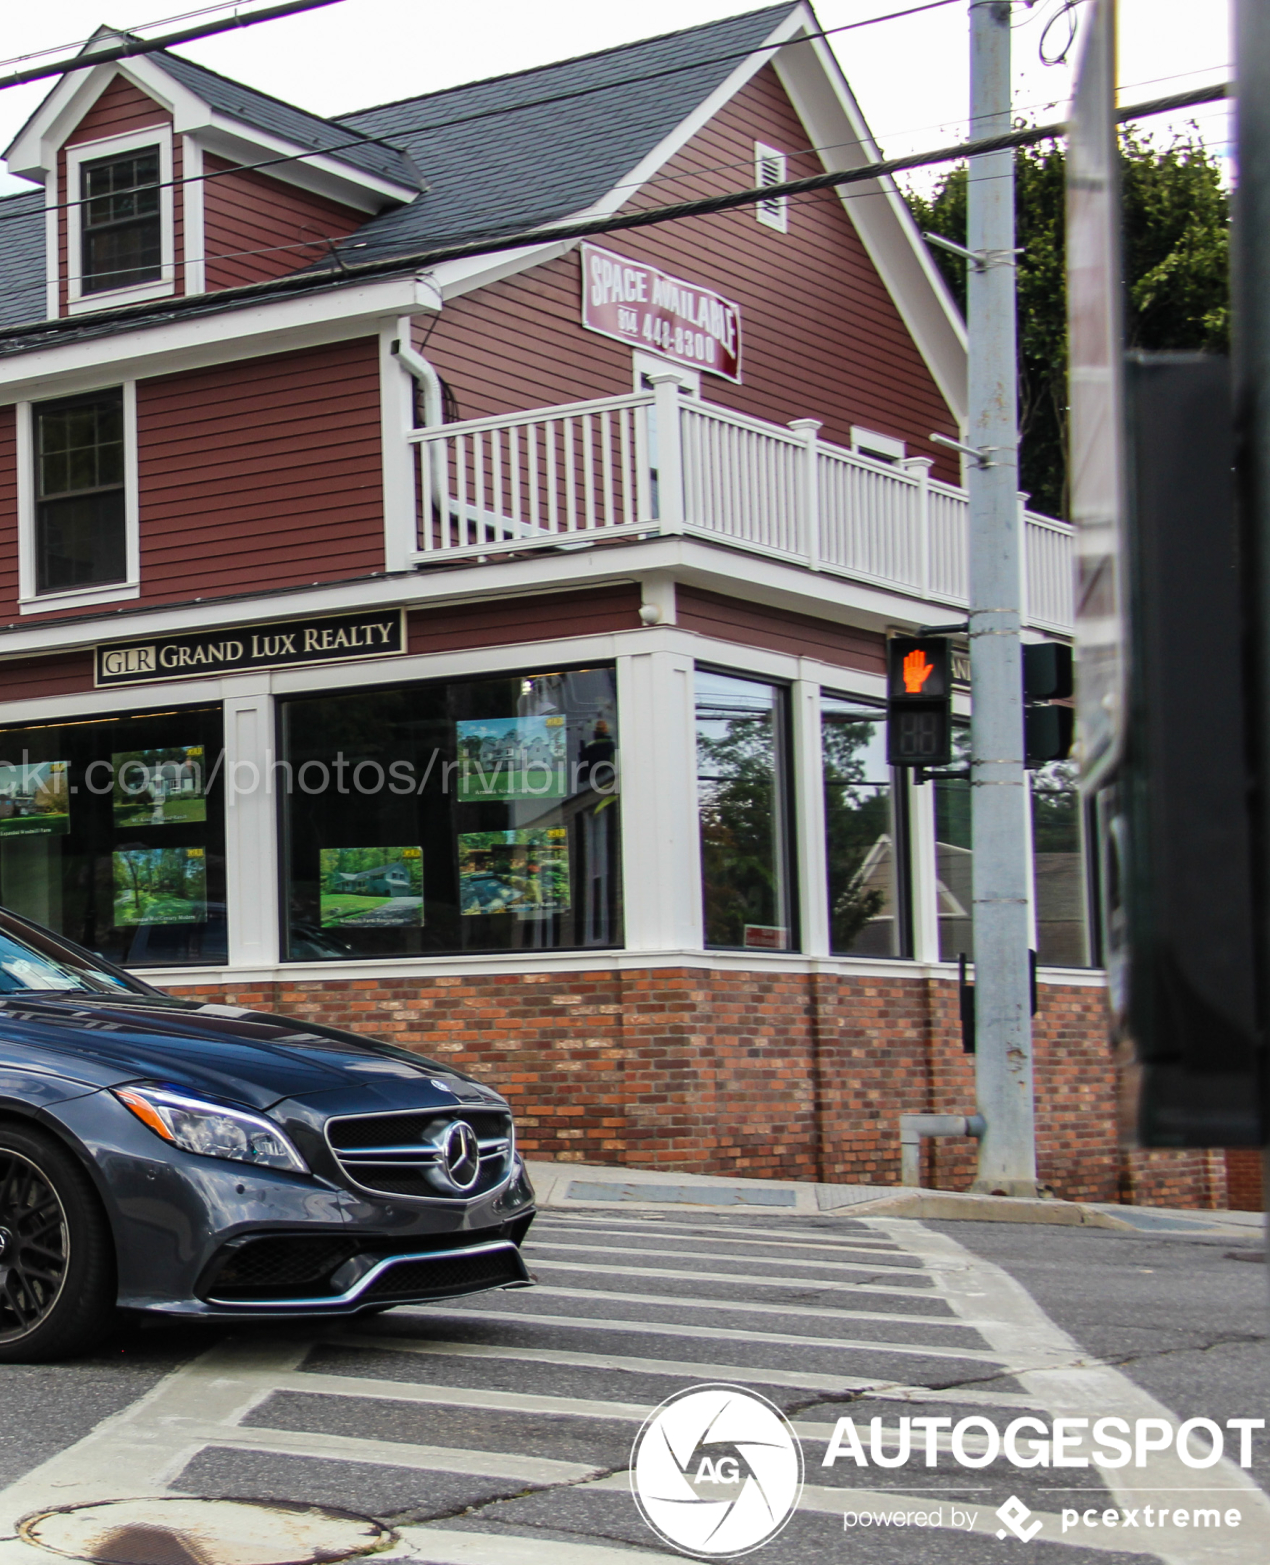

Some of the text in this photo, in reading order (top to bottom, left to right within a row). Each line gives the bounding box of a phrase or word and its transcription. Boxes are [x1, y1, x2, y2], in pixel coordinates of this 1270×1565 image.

[590, 255, 736, 360] SPACE AVAILABLE
[617, 308, 638, 334] 914
[104, 650, 154, 674] GLR
